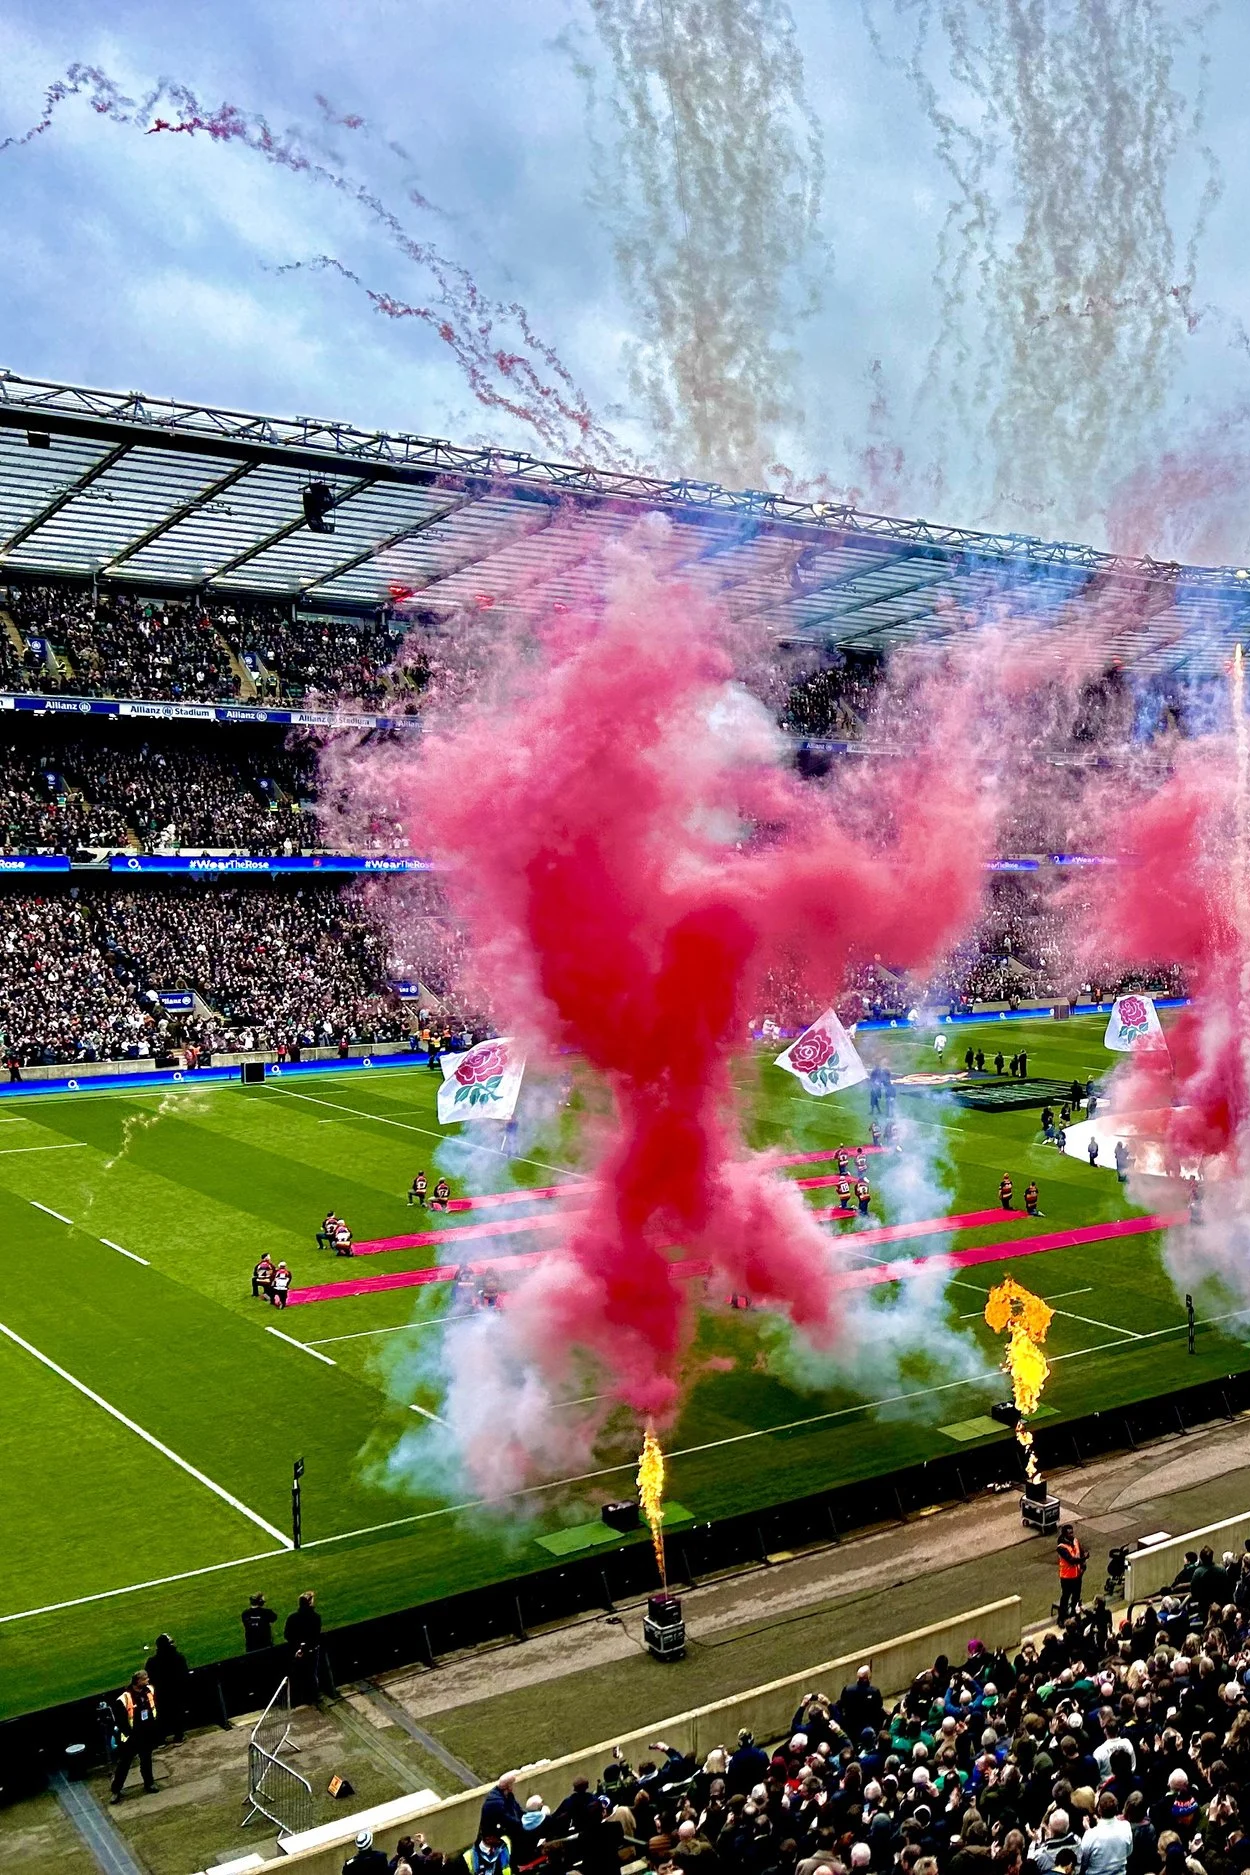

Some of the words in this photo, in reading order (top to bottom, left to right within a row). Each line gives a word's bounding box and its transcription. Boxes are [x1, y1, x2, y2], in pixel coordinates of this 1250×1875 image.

[45, 701, 77, 710] Allianz
[130, 705, 160, 714] Allianz
[175, 707, 210, 717] Stadium
[226, 710, 255, 719] Allianz
[298, 714, 326, 723] Allianz
[189, 859, 270, 870] #WearTheRose
[364, 860, 435, 870] #WearTheRose
